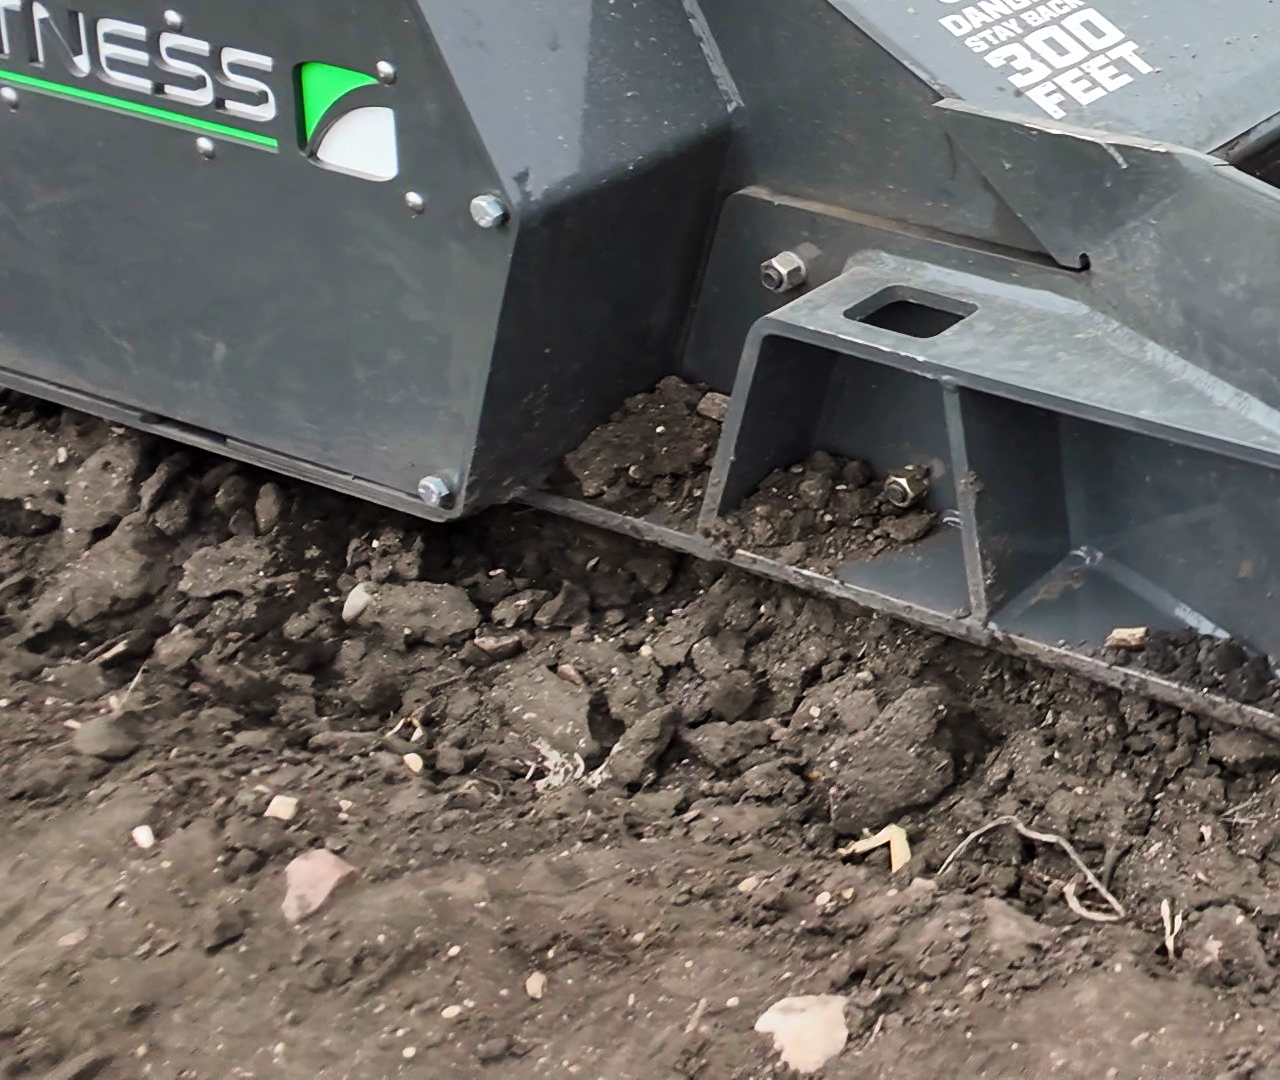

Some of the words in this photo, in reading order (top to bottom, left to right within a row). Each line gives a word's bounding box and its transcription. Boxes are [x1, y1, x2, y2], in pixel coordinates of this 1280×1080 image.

[963, 17, 1024, 53] STAY
[983, 7, 1126, 88] 300
[1024, 40, 1154, 120] FEET
